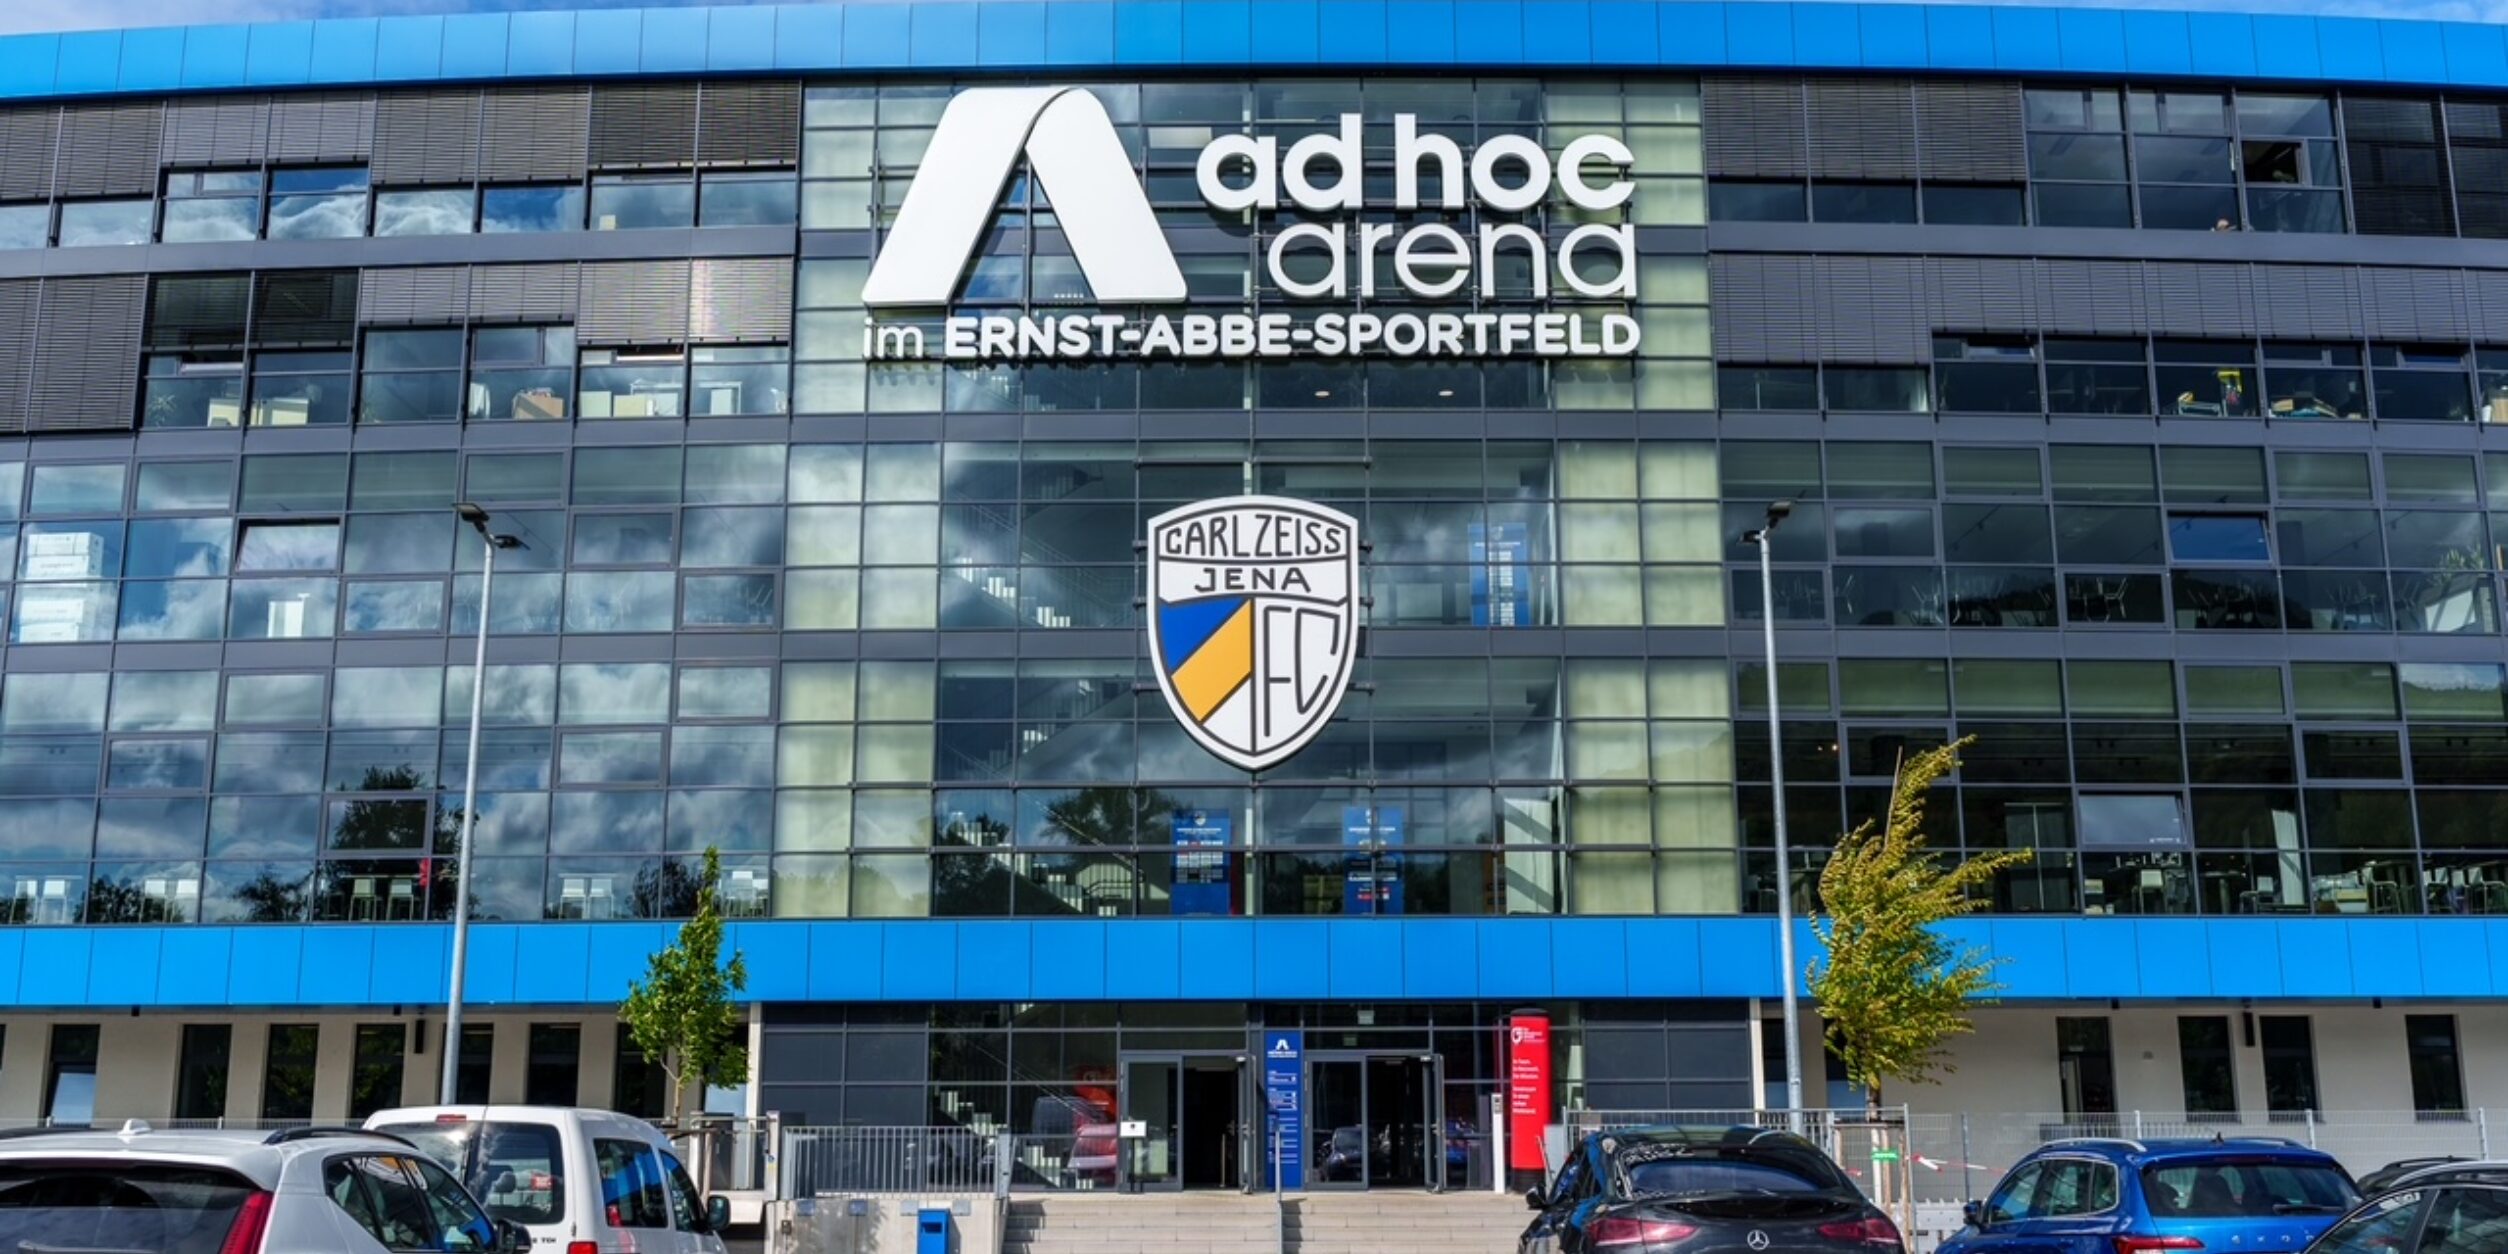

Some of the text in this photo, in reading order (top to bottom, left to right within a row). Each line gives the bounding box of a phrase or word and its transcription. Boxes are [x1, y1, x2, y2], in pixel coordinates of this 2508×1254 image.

[1196, 112, 1636, 211] ad hoc
[1267, 222, 1638, 298] arena
[863, 313, 1641, 358] im ERNST-ABBE-SPORTFELD
[1165, 514, 1341, 557] CARL ZEISS
[1194, 567, 1312, 593] JENA
[1263, 605, 1341, 738] FC
